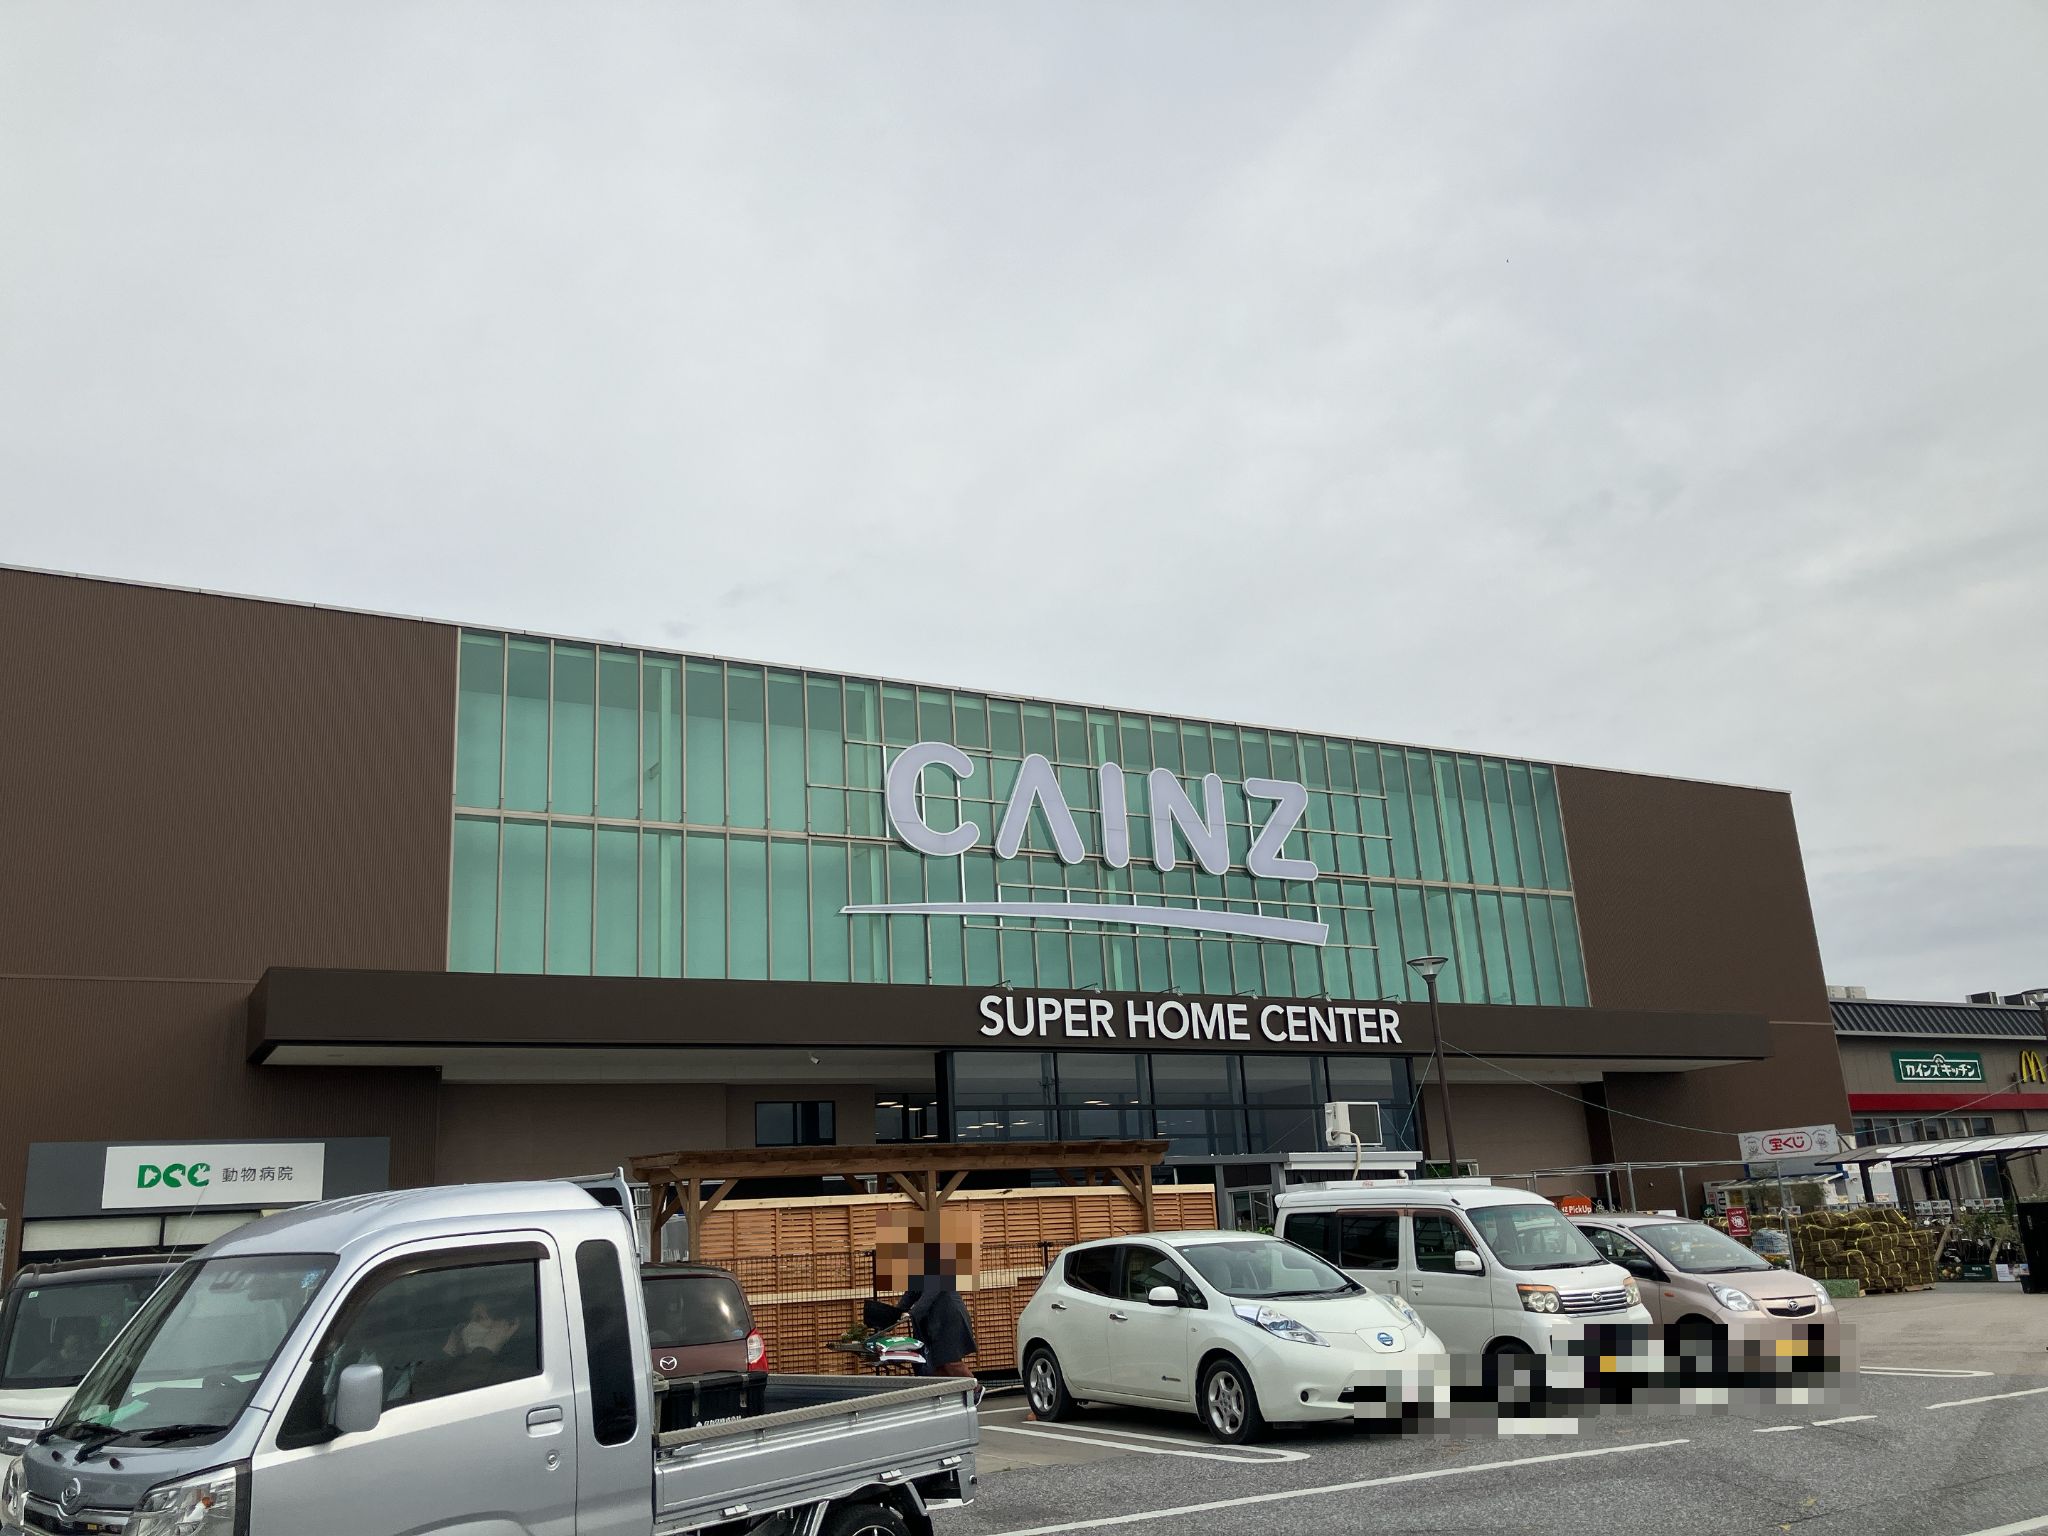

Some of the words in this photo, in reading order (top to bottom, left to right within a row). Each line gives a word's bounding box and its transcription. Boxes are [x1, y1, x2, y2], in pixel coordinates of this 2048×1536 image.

[885, 740, 1320, 882] CAINZ
[979, 995, 1116, 1039] SUPER
[1127, 1000, 1251, 1041] HOME
[1260, 1004, 1403, 1045] CENTER
[1769, 1136, 1805, 1152] 宝くじ
[137, 1162, 211, 1189] DCC
[221, 1165, 294, 1183] 動物病院
